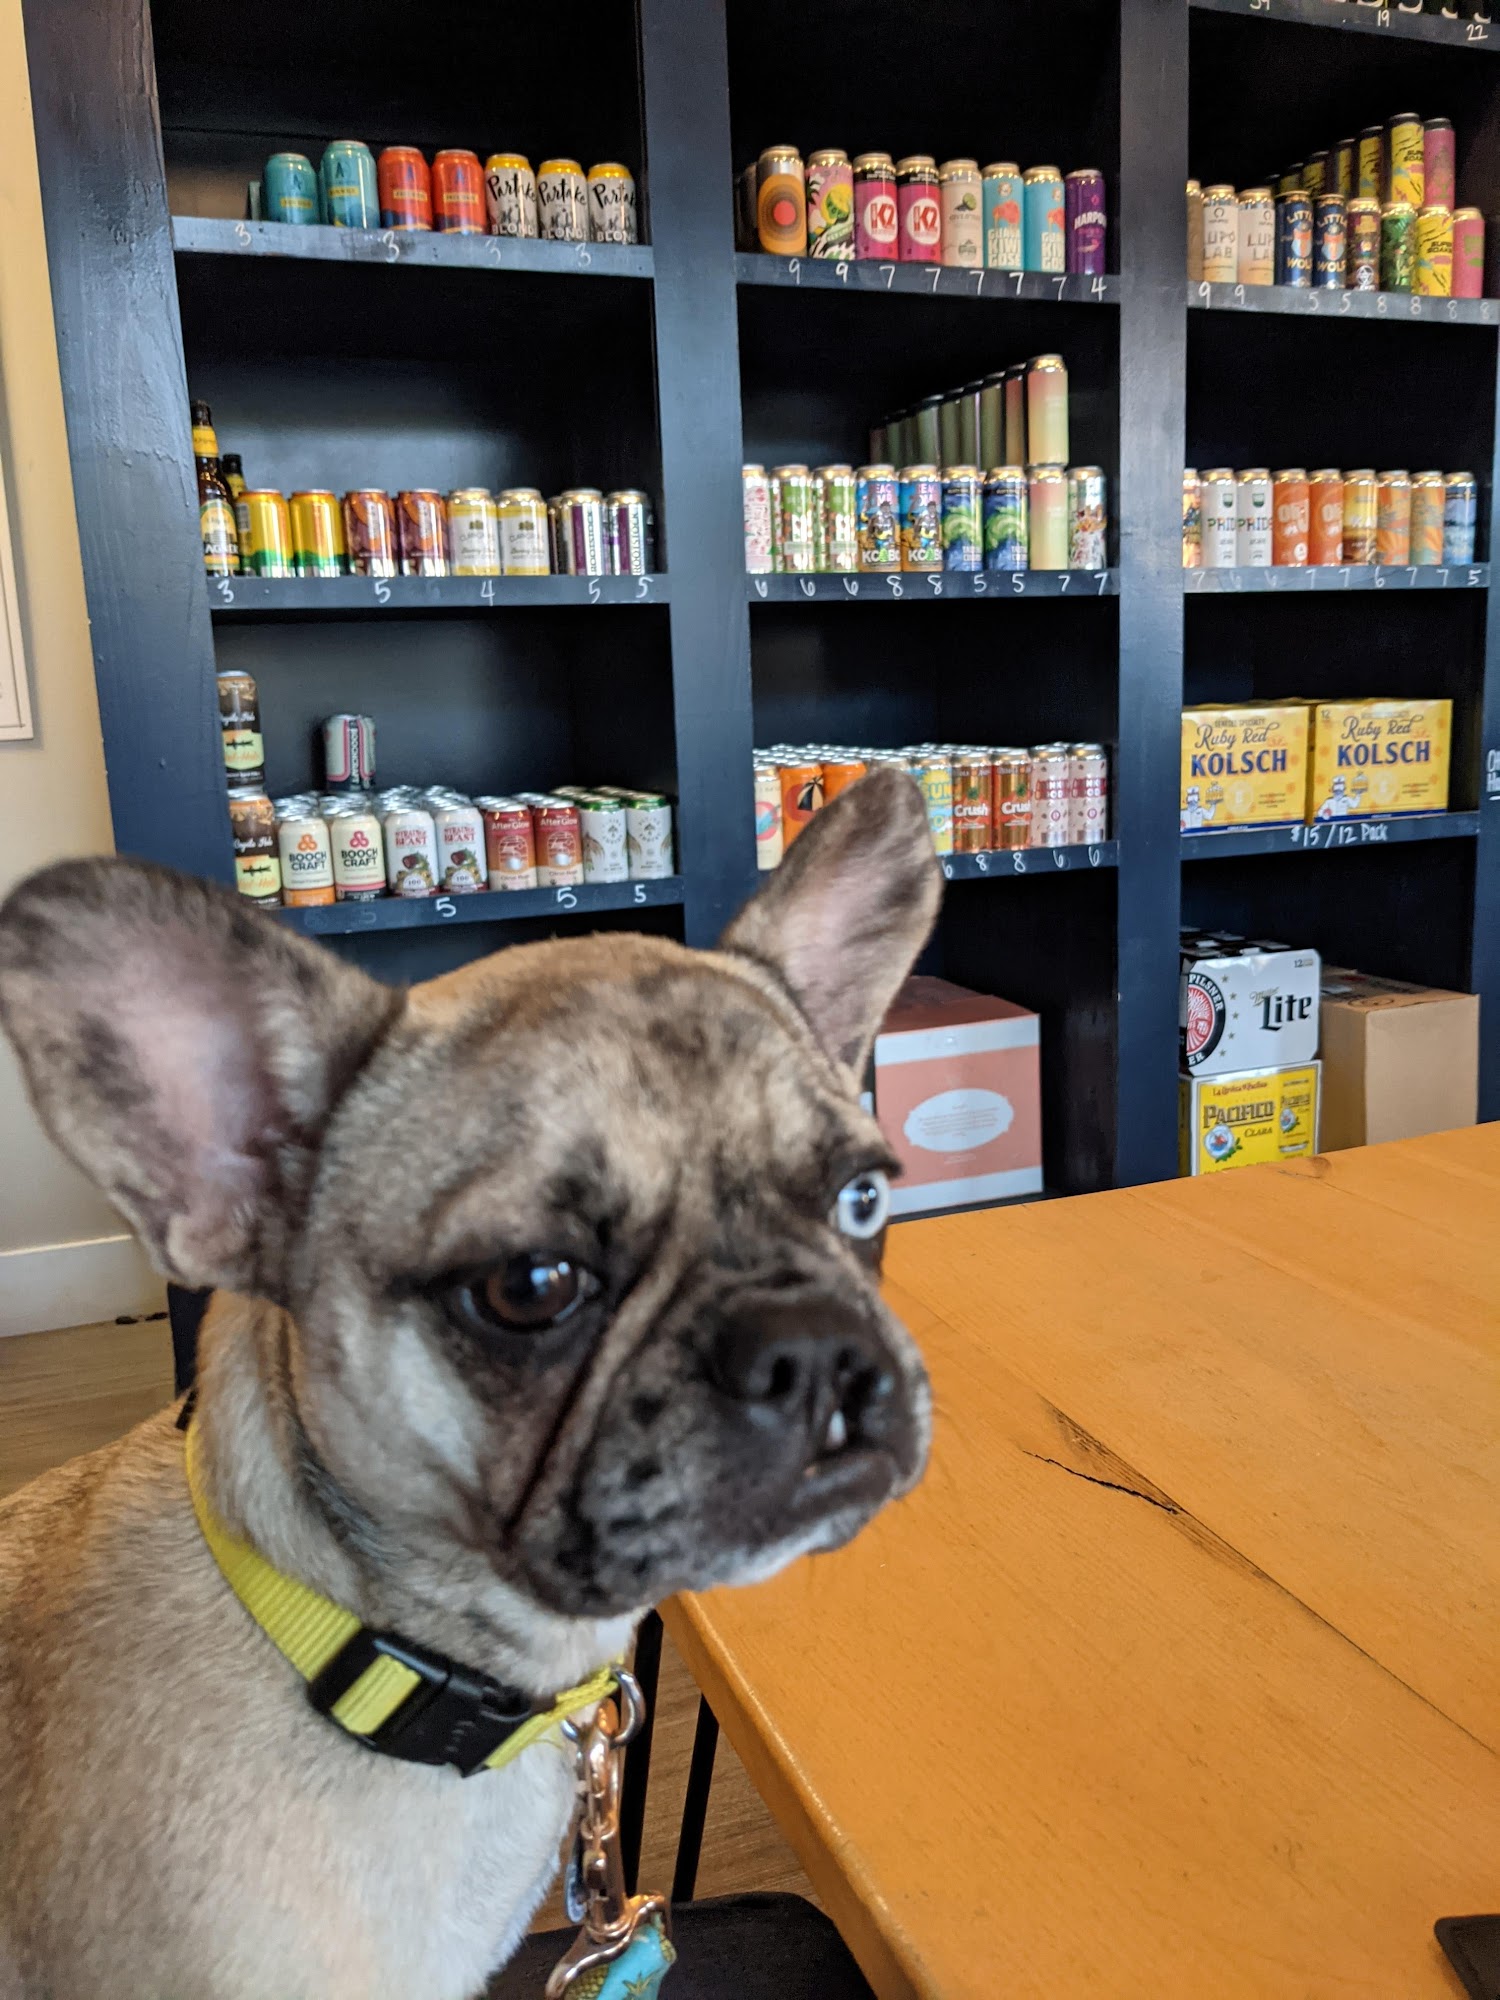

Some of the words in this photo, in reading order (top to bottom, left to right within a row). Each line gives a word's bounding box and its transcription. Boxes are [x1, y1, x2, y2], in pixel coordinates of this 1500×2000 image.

[1378, 10, 1390, 27] 19
[1466, 24, 1488, 40] 22
[537, 178, 587, 206] Partake
[235, 223, 251, 246] 3
[382, 231, 399, 262] 3
[575, 242, 591, 267] 3
[789, 258, 800, 284] 9
[836, 262, 849, 283] 9
[879, 265, 895, 289] 7
[925, 268, 940, 292] 7
[969, 270, 984, 295] 7
[1009, 272, 1024, 296] 7
[1052, 276, 1067, 301] 7
[1090, 276, 1107, 301] 4
[1199, 281, 1210, 310] 9
[1234, 284, 1244, 304] 9
[1309, 291, 1319, 312] 5
[1341, 292, 1351, 314] 5
[1377, 295, 1387, 313] 8
[1410, 296, 1421, 314] 8
[1447, 300, 1458, 319] 8
[886, 575, 904, 596] 8
[927, 574, 942, 595] 8
[974, 574, 987, 593] 5
[1012, 573, 1025, 593] 5
[1058, 575, 1070, 592] 7
[1094, 572, 1108, 596] 7
[1192, 571, 1206, 588] 7
[1306, 568, 1318, 590] 7
[1338, 568, 1350, 588] 7
[1374, 566, 1385, 588] 6
[1406, 566, 1418, 586] 7
[1436, 568, 1448, 586] 7
[1467, 569, 1482, 586] 5
[218, 579, 234, 603] 3
[374, 578, 391, 604] 5
[480, 579, 496, 606] 4
[589, 578, 600, 604] 5
[636, 576, 654, 599] 5
[755, 578, 768, 598] 6
[800, 578, 816, 596] 6
[1194, 724, 1237, 752] Ruby
[1242, 722, 1280, 744] Red
[1341, 716, 1382, 742] Ruby
[1387, 714, 1424, 736] Red
[1191, 749, 1288, 778] KOLSCH
[1337, 740, 1431, 767] KOLSCH
[954, 803, 990, 817] Crush
[1361, 823, 1388, 842] Pack
[289, 851, 327, 862] BOOCH
[341, 848, 378, 859] BOOCH
[343, 858, 376, 868] CRAFT
[975, 854, 987, 872] 8
[1013, 852, 1026, 873] 8
[1053, 850, 1064, 868] 6
[1088, 846, 1100, 867] 6
[291, 861, 325, 871] CRAFT
[557, 886, 578, 909] 5
[635, 884, 647, 904] 5
[435, 896, 456, 918] 5
[1188, 973, 1224, 1012] PILSNER
[1260, 994, 1312, 1032] Lite
